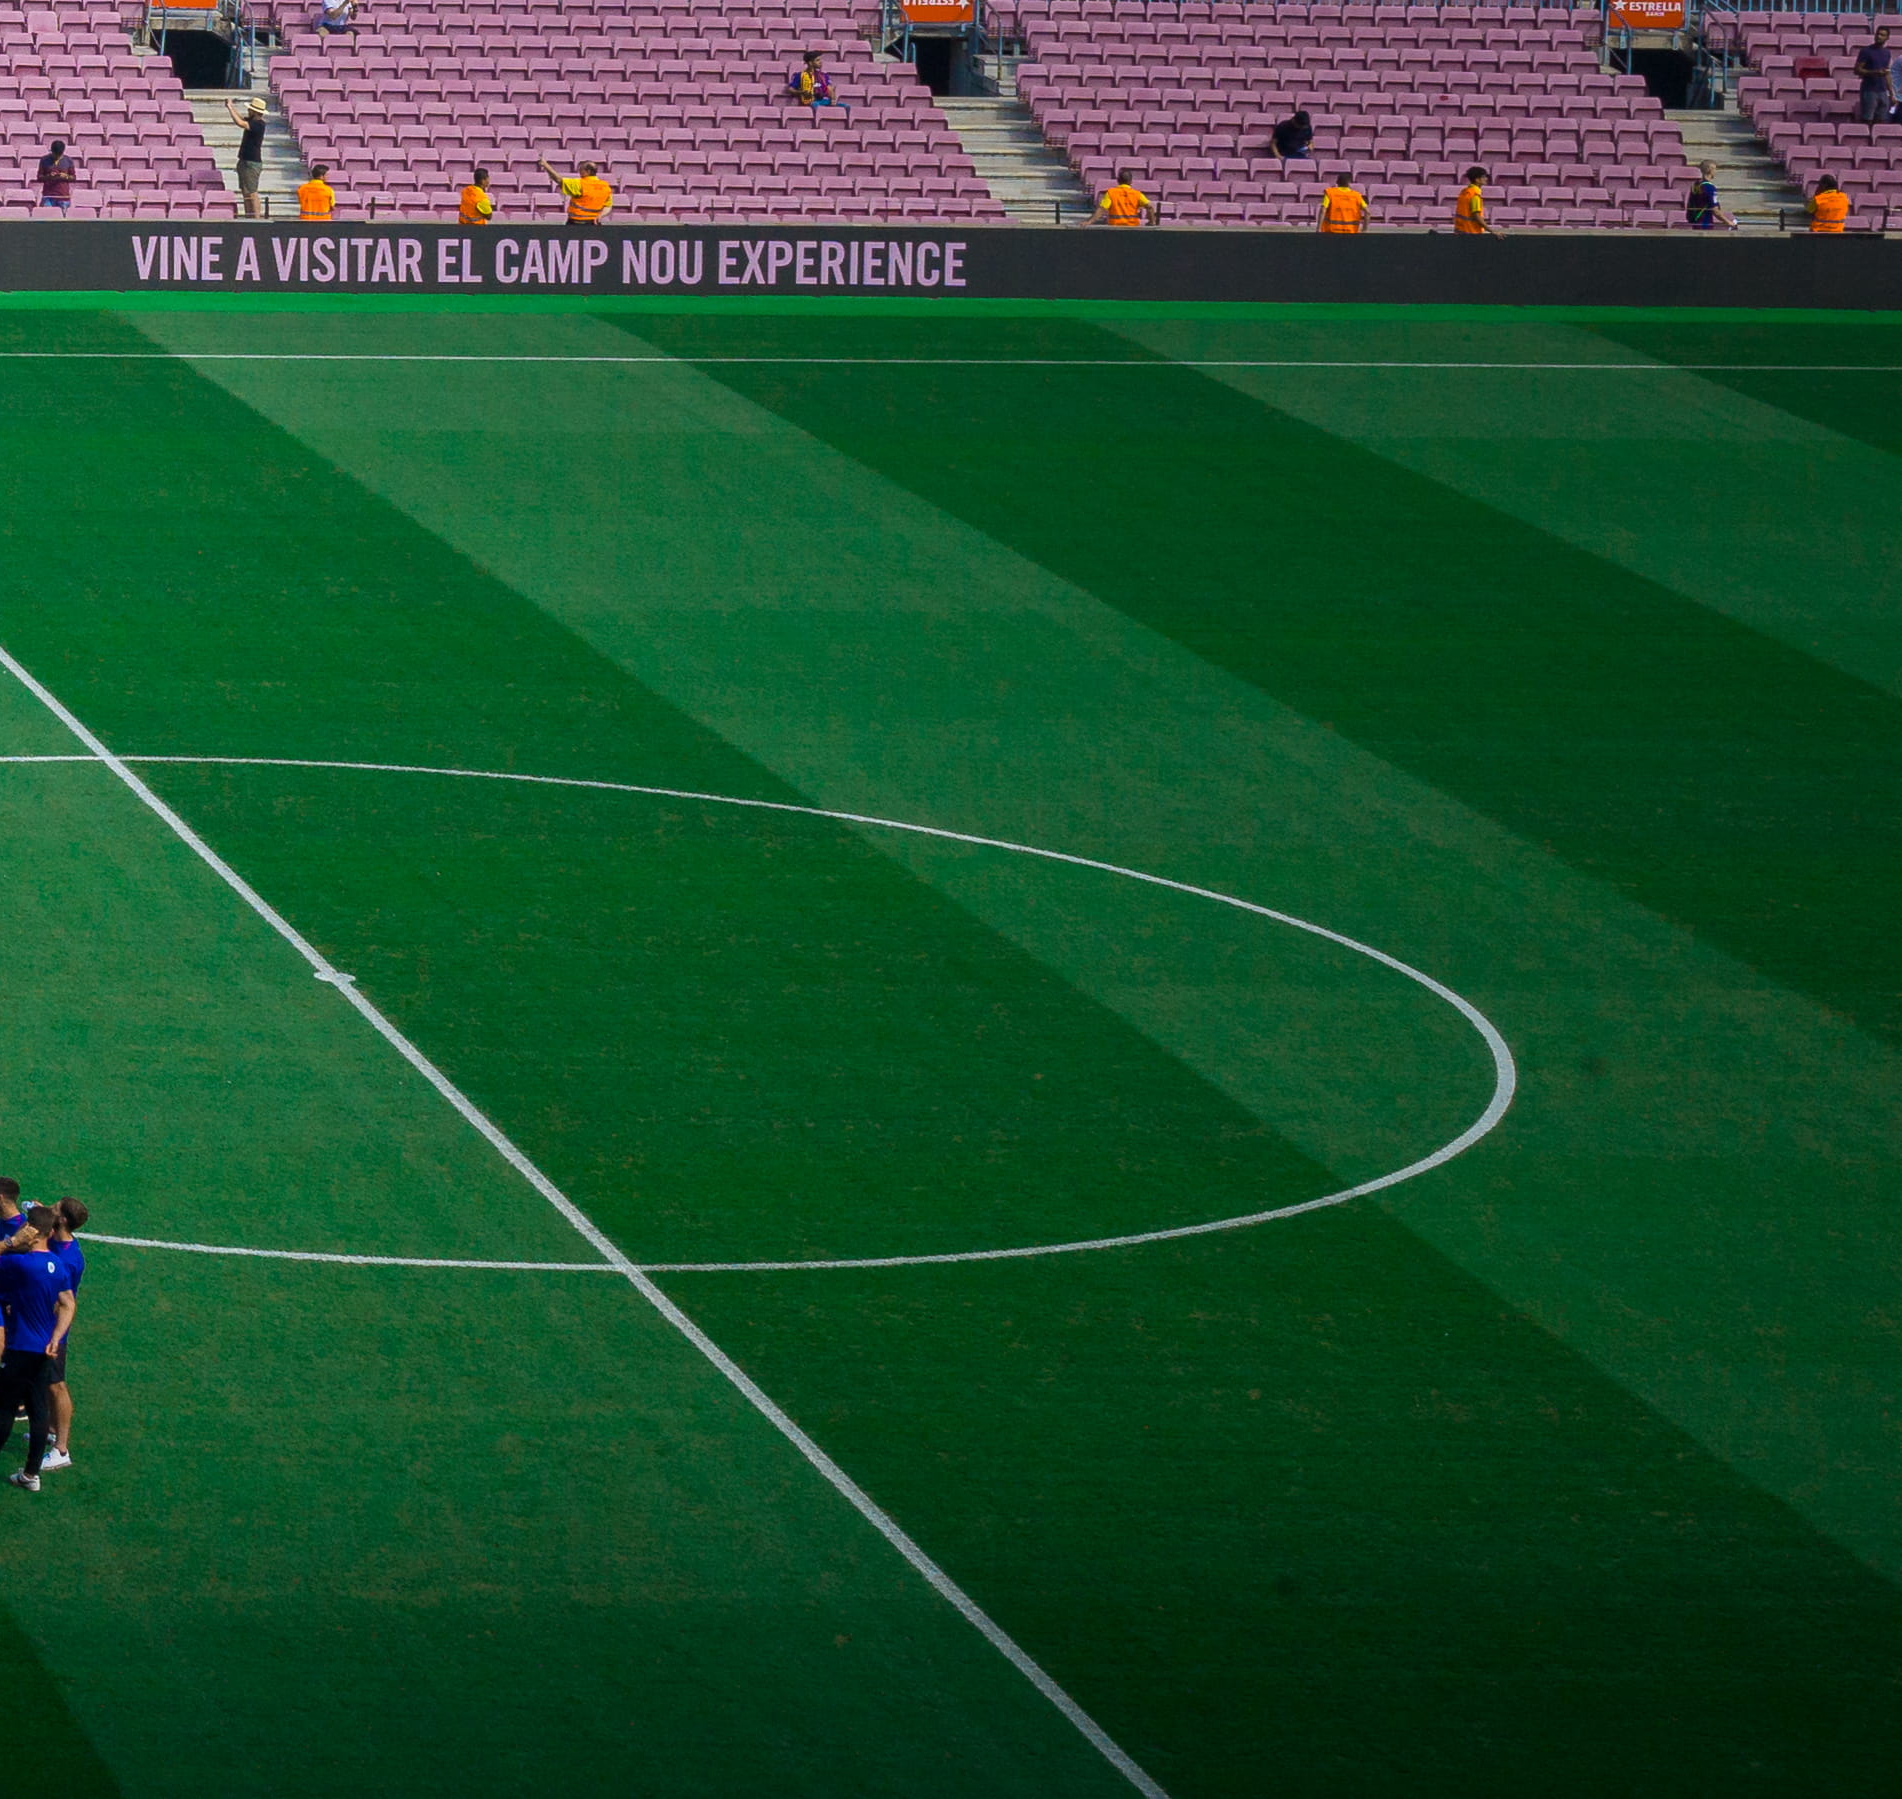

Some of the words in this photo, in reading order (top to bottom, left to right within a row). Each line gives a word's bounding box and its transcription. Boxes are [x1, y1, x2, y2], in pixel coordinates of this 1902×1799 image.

[1629, 1, 1682, 12] ESTRELLA
[131, 235, 224, 281] VINE
[235, 236, 261, 282] A
[272, 236, 424, 283] VISITAR
[437, 238, 483, 283] EL
[495, 238, 609, 284] CAMP
[622, 239, 704, 285] NOU
[718, 240, 968, 287] EXPERIENCE
